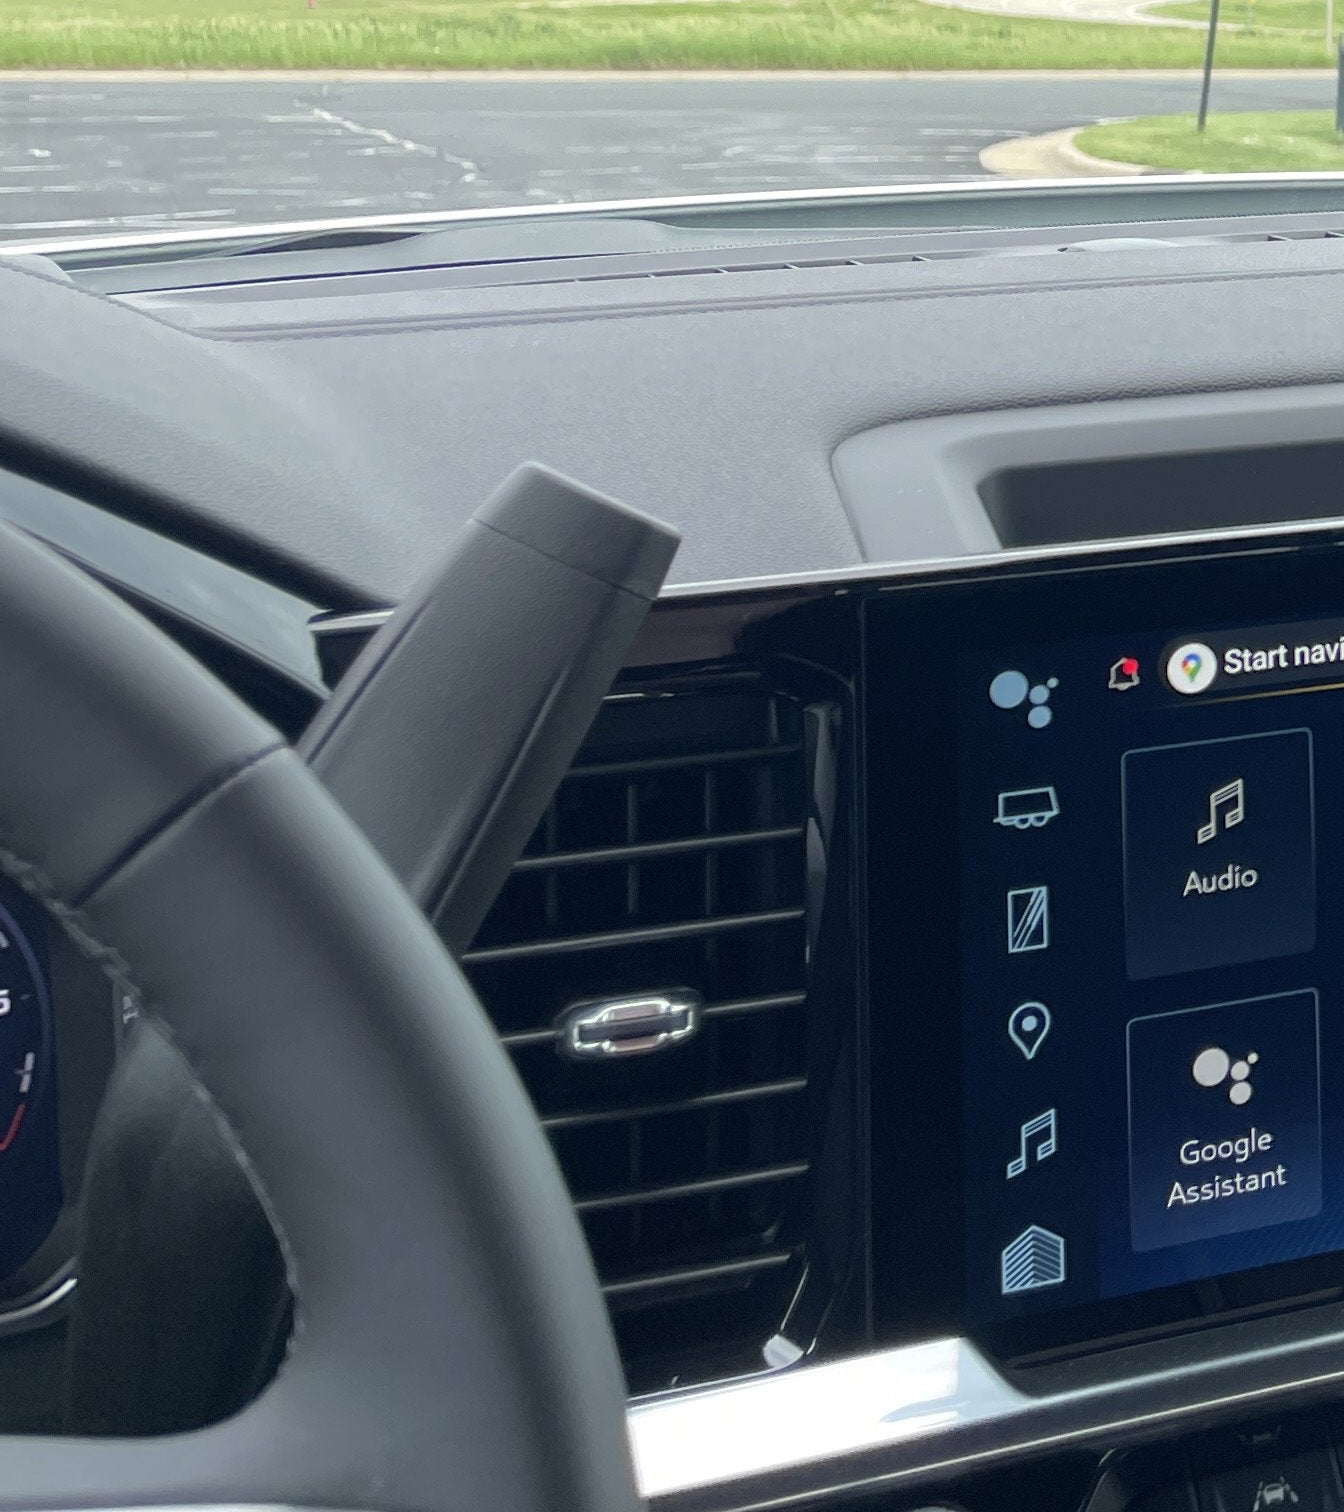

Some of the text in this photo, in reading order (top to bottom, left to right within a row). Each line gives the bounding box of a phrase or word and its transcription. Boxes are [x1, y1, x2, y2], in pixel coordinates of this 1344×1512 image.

[1223, 643, 1289, 675] Start
[1182, 864, 1259, 898] Audio
[1179, 1127, 1275, 1165] Google
[1166, 1164, 1288, 1209] Assistant
